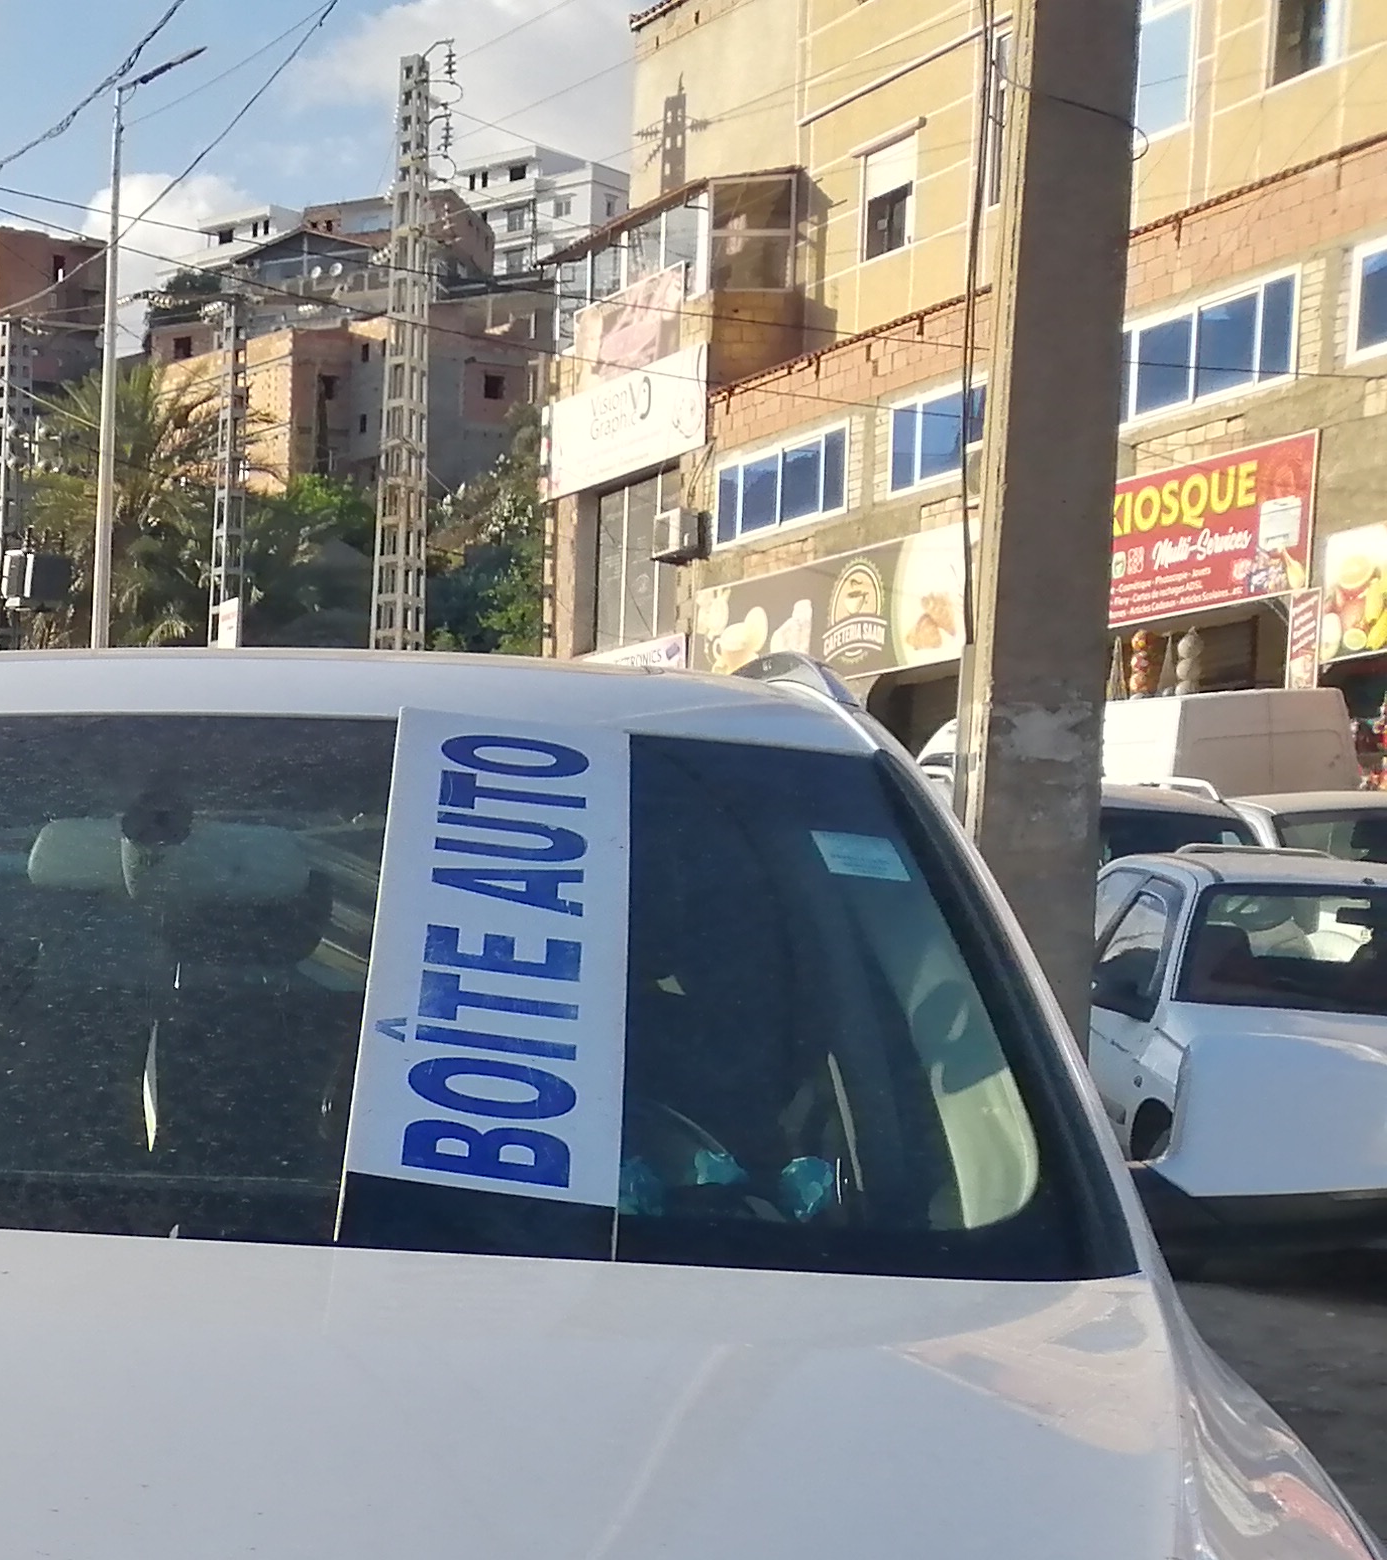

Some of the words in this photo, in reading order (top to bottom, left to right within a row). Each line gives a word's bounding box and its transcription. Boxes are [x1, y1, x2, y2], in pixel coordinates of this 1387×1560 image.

[591, 389, 628, 417] Vision
[1152, 527, 1252, 570] Multi-Services
[431, 734, 589, 917] AUTO
[375, 923, 582, 1189] BOÎTE
